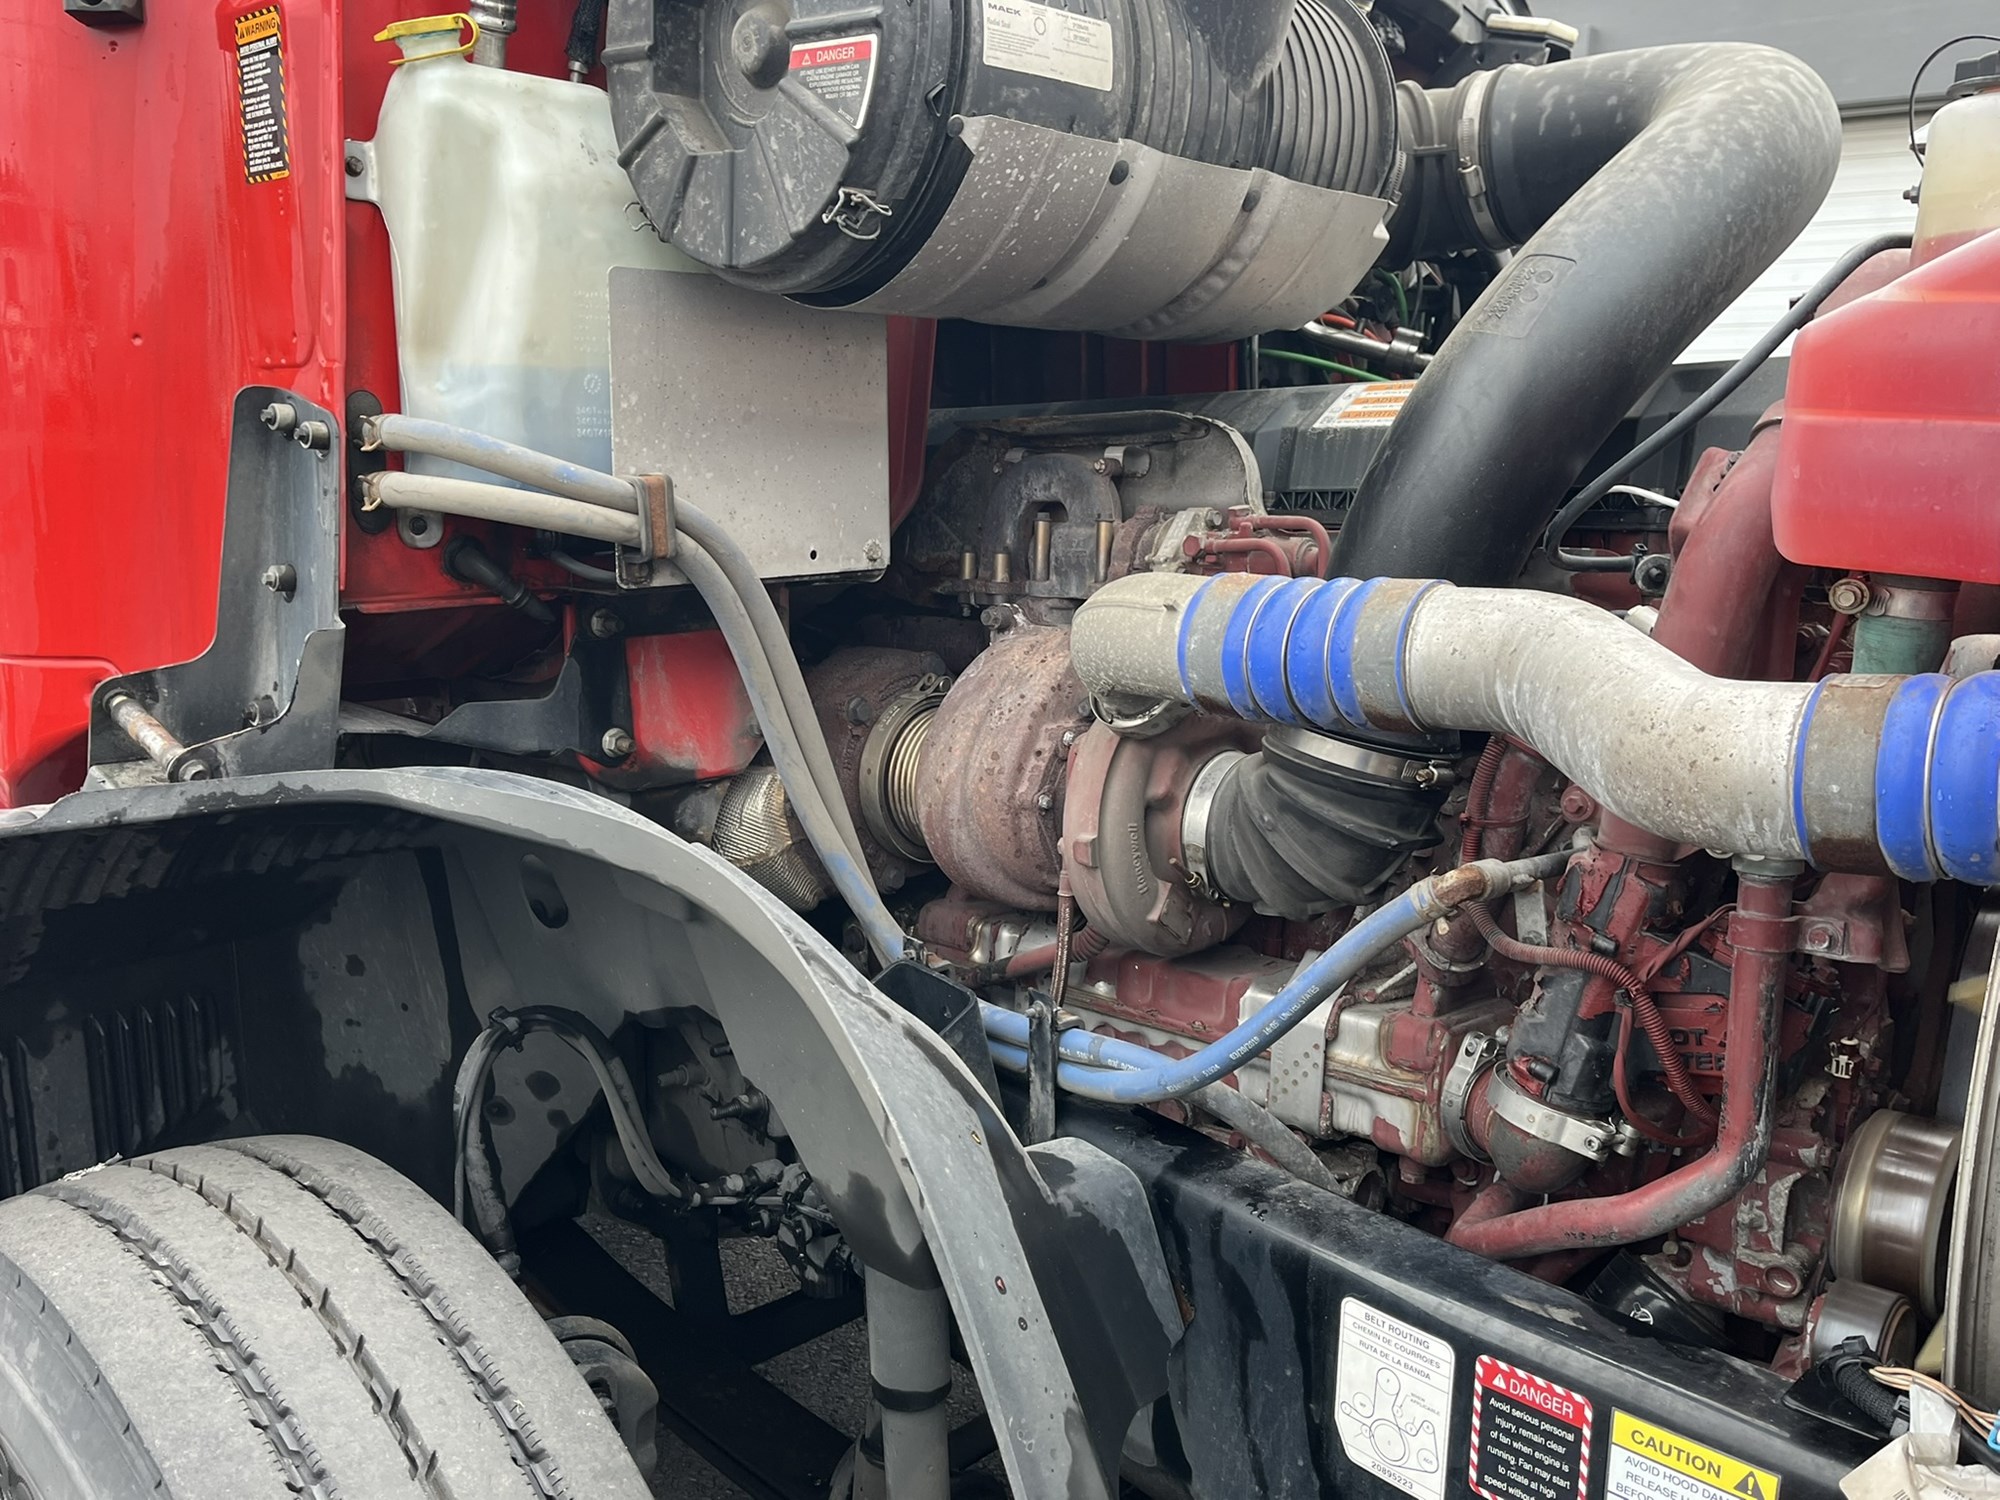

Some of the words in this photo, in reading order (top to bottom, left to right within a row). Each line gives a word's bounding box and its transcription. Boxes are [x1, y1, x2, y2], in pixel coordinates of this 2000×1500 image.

[245, 17, 276, 37] WARNING
[988, 2, 1022, 17] MACK
[816, 46, 855, 63] DANGER
[1127, 822, 1149, 895] Honeywell
[1352, 1321, 1382, 1341] CHEMIN
[1382, 1336, 1393, 1347] DE
[1394, 1341, 1441, 1370] COURROIES
[1364, 1312, 1386, 1329] BELT
[1388, 1325, 1431, 1350] ROUTING
[1359, 1339, 1379, 1355] RUTA
[1379, 1350, 1391, 1361] DE
[1391, 1356, 1402, 1366] LA
[1403, 1362, 1431, 1381] BANDA
[1410, 1398, 1441, 1417] APPLICABLE
[1509, 1378, 1574, 1419] DANGER
[1489, 1397, 1511, 1414] Avoid
[1511, 1408, 1540, 1426] serious
[1540, 1420, 1575, 1442] personal
[1495, 1415, 1518, 1433] injury,
[1518, 1427, 1546, 1446] remain
[1546, 1438, 1567, 1455] clear
[1487, 1444, 1518, 1466] running.
[1518, 1457, 1534, 1472] Fan
[1534, 1466, 1552, 1482] may
[1552, 1475, 1571, 1490] start
[1490, 1429, 1498, 1439] of
[1499, 1433, 1511, 1446] fan
[1512, 1439, 1534, 1456] when
[1534, 1450, 1561, 1469] engine
[1562, 1461, 1570, 1473] is
[1630, 1429, 1723, 1479] CAUTION
[1371, 1460, 1414, 1490] 20895223
[1484, 1474, 1507, 1492] speed
[1498, 1464, 1506, 1475] to
[1507, 1470, 1529, 1486] rotate
[1530, 1480, 1538, 1490] at
[1539, 1482, 1557, 1499] high
[1624, 1455, 1661, 1478] AVOID
[1662, 1469, 1700, 1495] HOOD
[1625, 1470, 1679, 1500] RELEASE
